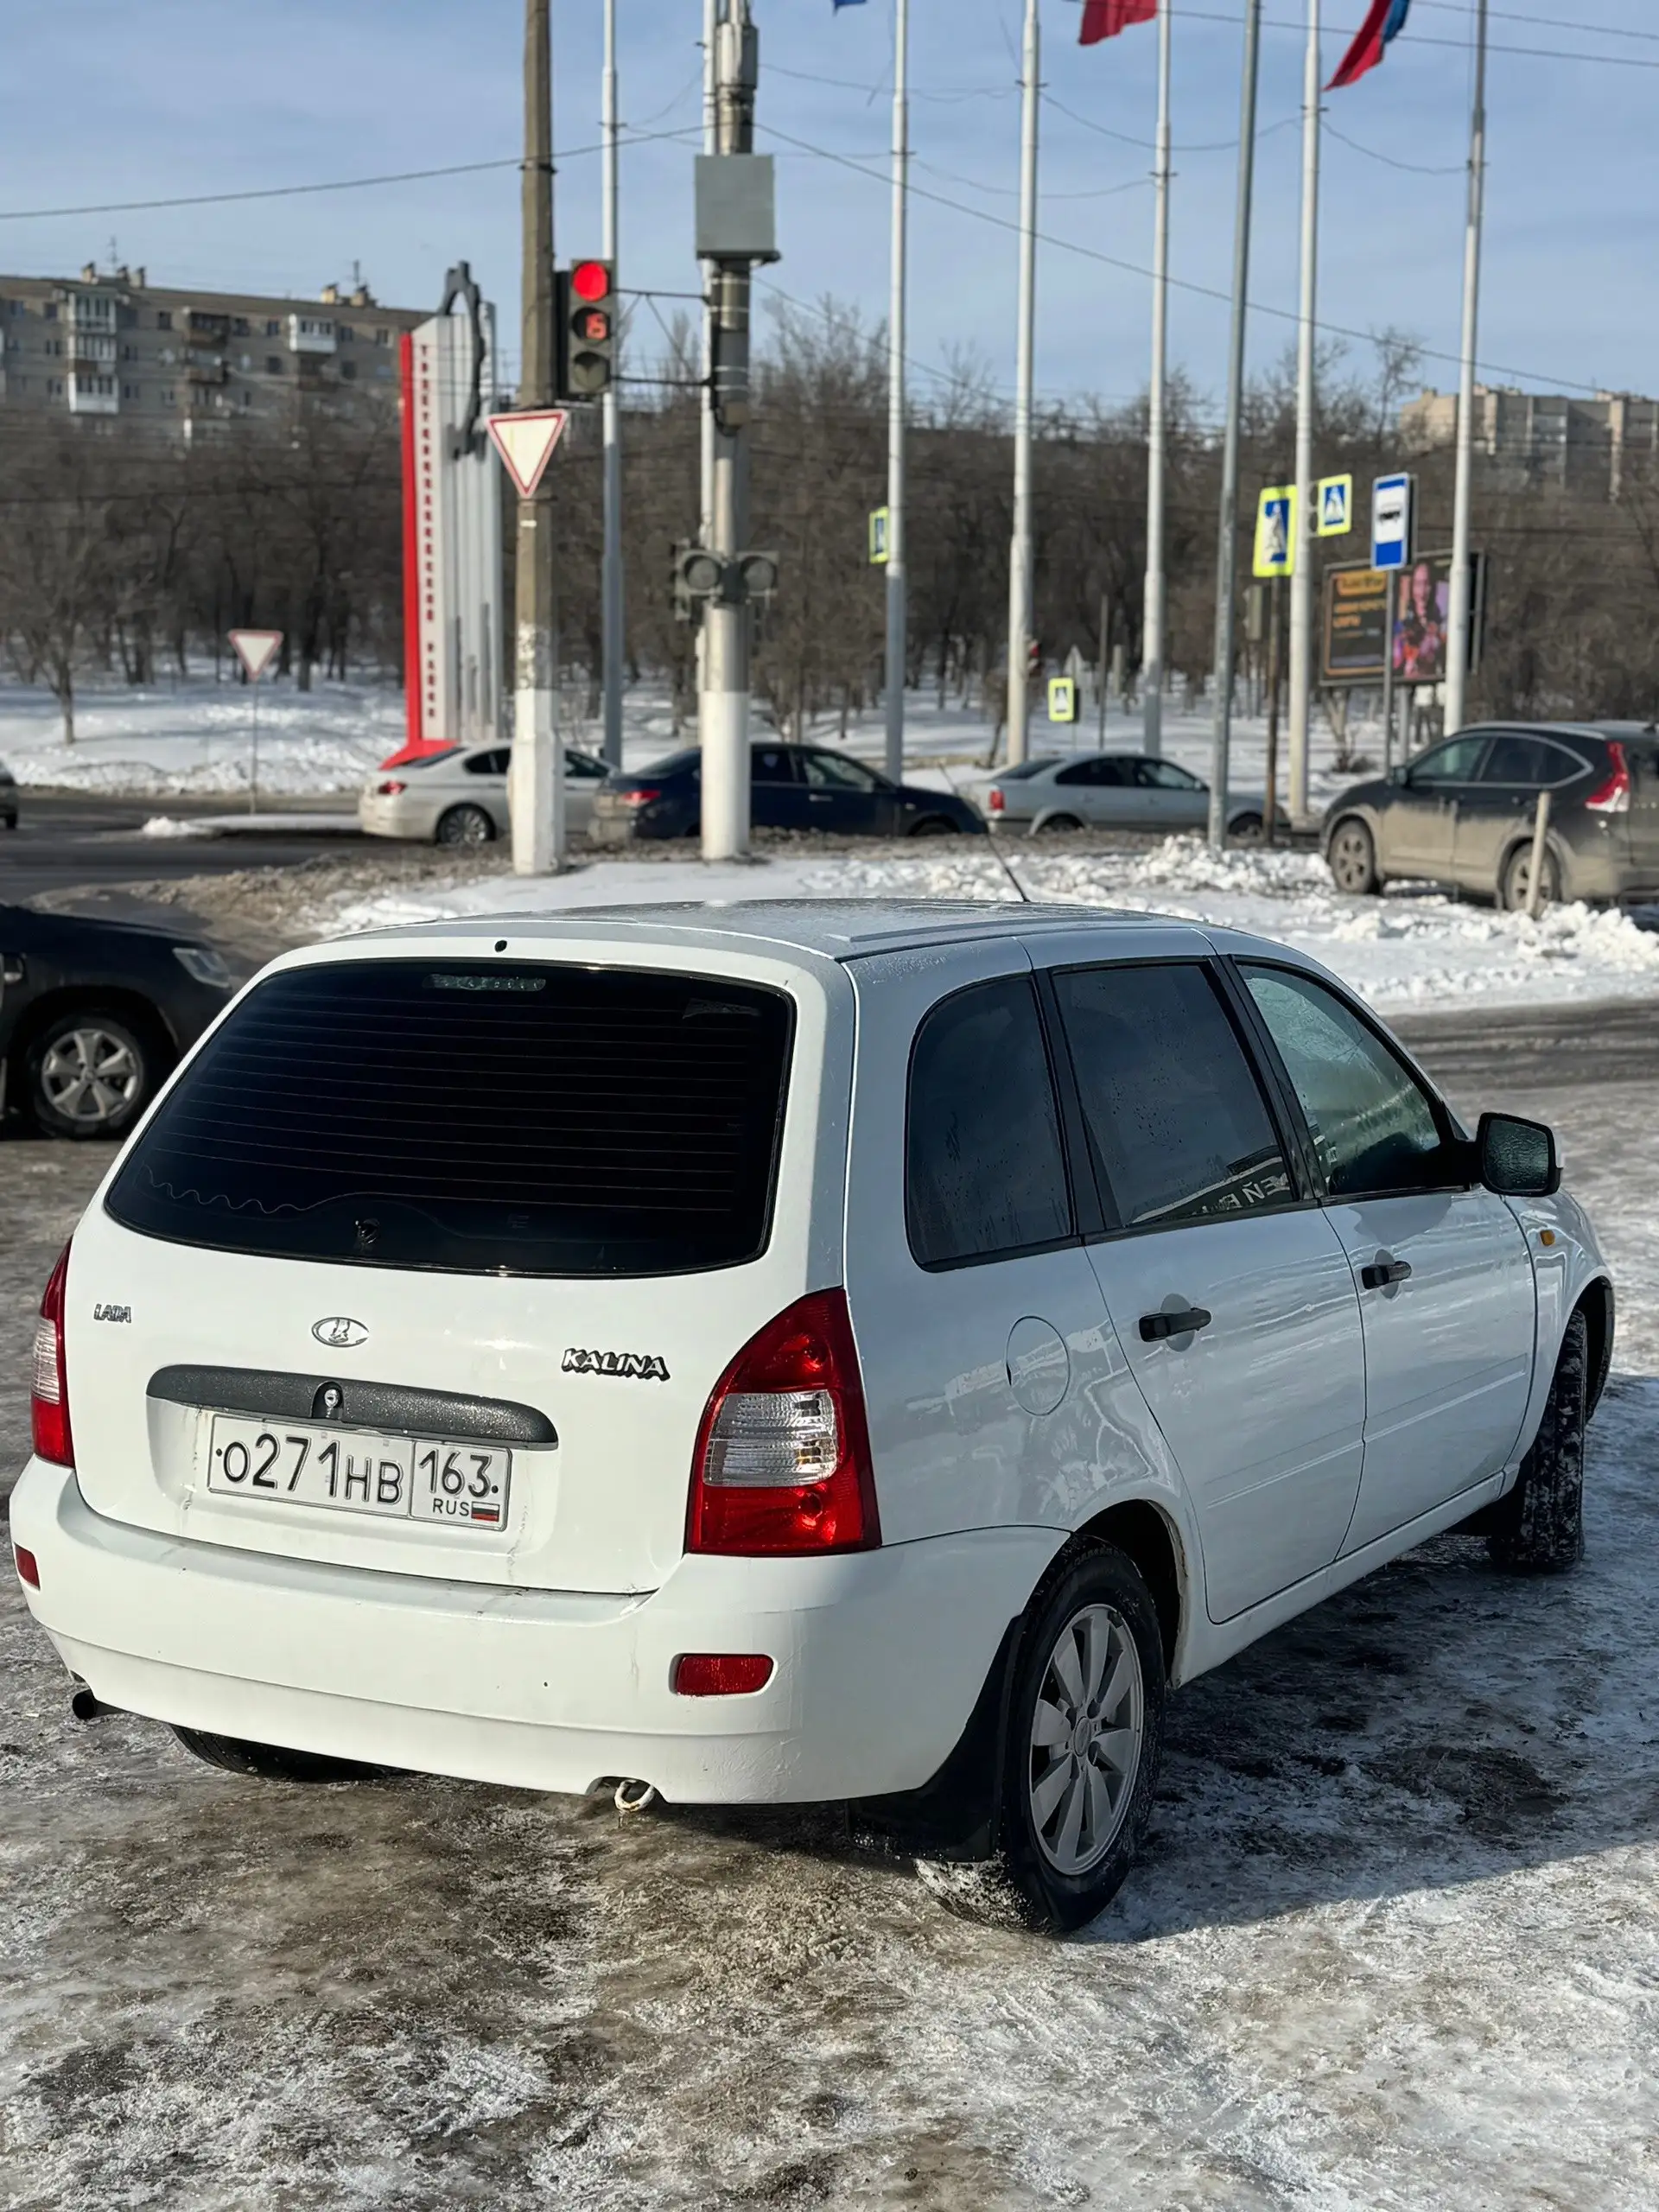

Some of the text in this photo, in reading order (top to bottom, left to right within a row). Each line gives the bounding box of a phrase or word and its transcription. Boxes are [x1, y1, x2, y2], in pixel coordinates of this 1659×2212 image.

[93, 1303, 132, 1324] LADA
[562, 1348, 671, 1382] KALINA
[419, 1448, 493, 1497] 163
[432, 1497, 470, 1516] RUS
